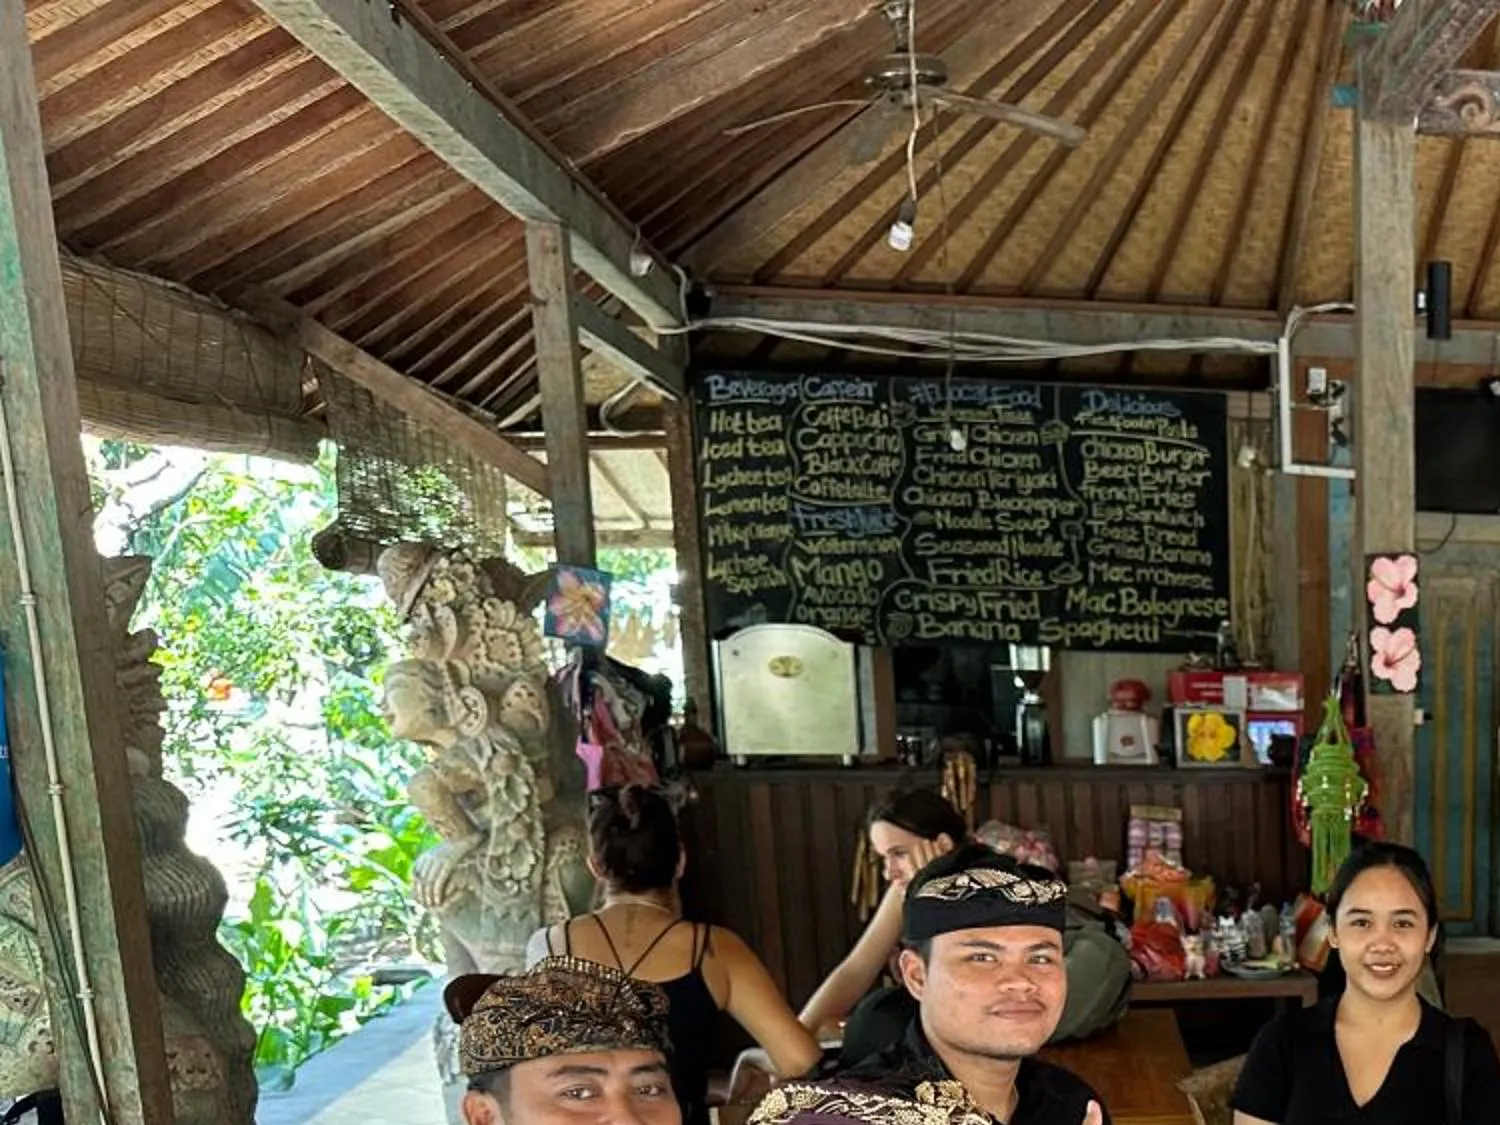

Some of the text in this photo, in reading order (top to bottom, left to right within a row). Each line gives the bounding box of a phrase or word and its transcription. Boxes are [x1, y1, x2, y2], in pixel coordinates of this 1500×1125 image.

[1081, 390, 1182, 417] Delicious
[710, 410, 745, 434] Hot
[995, 512, 1050, 537] Soup
[790, 556, 884, 588] Mango
[928, 558, 1043, 586] Fried Rice
[1088, 561, 1134, 586] Mac
[977, 590, 1041, 620] Fried
[1065, 587, 1229, 628] Mac Bolognese
[915, 612, 1022, 641] Banana
[1039, 616, 1160, 647] Spaghetti
